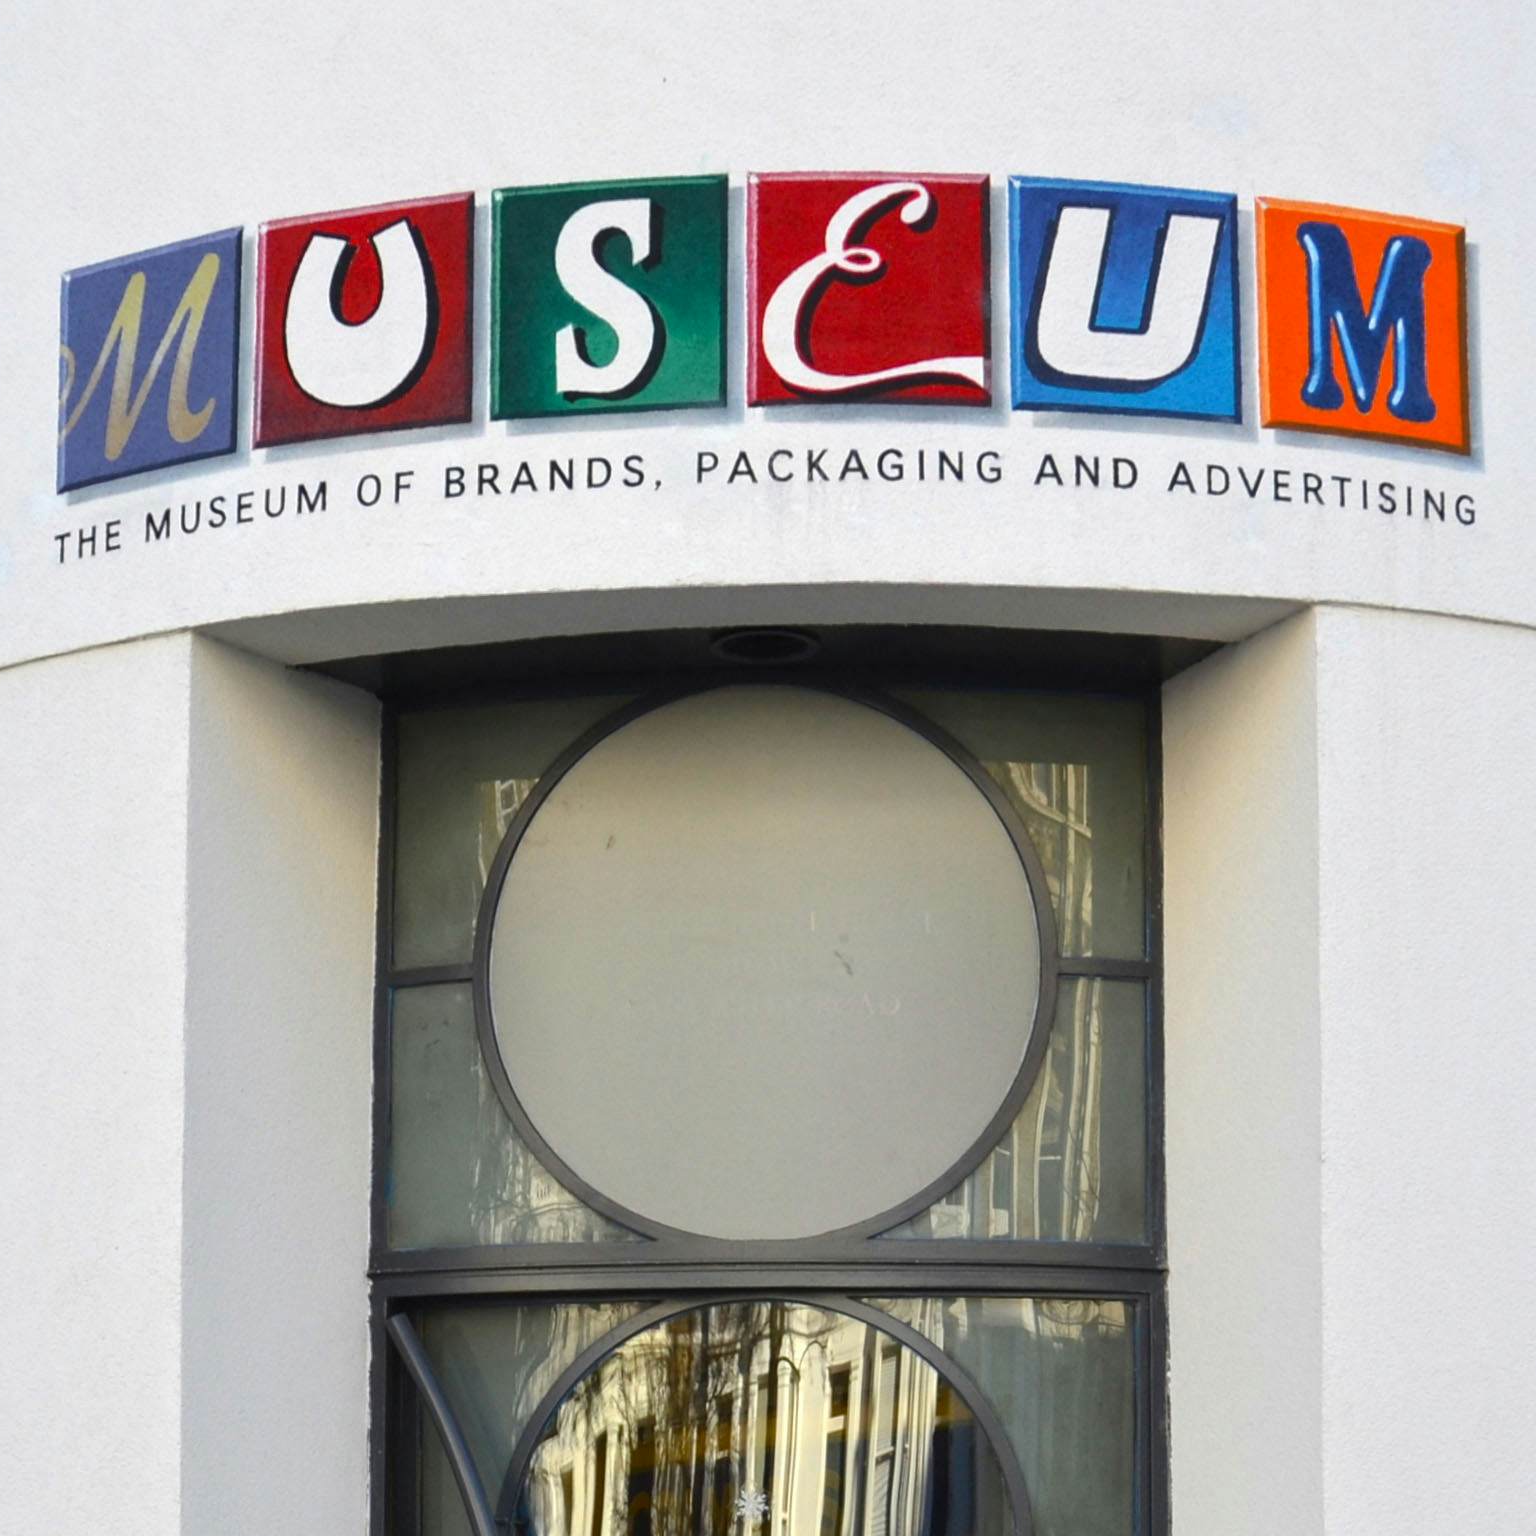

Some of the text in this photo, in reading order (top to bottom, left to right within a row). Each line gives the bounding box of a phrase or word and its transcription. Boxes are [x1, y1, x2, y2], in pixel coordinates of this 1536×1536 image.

[58, 180, 1438, 462] MUSEUM
[54, 448, 1478, 565] THE MUSEUM OF BRANDS, PACKAGING AND ADVERTISING
